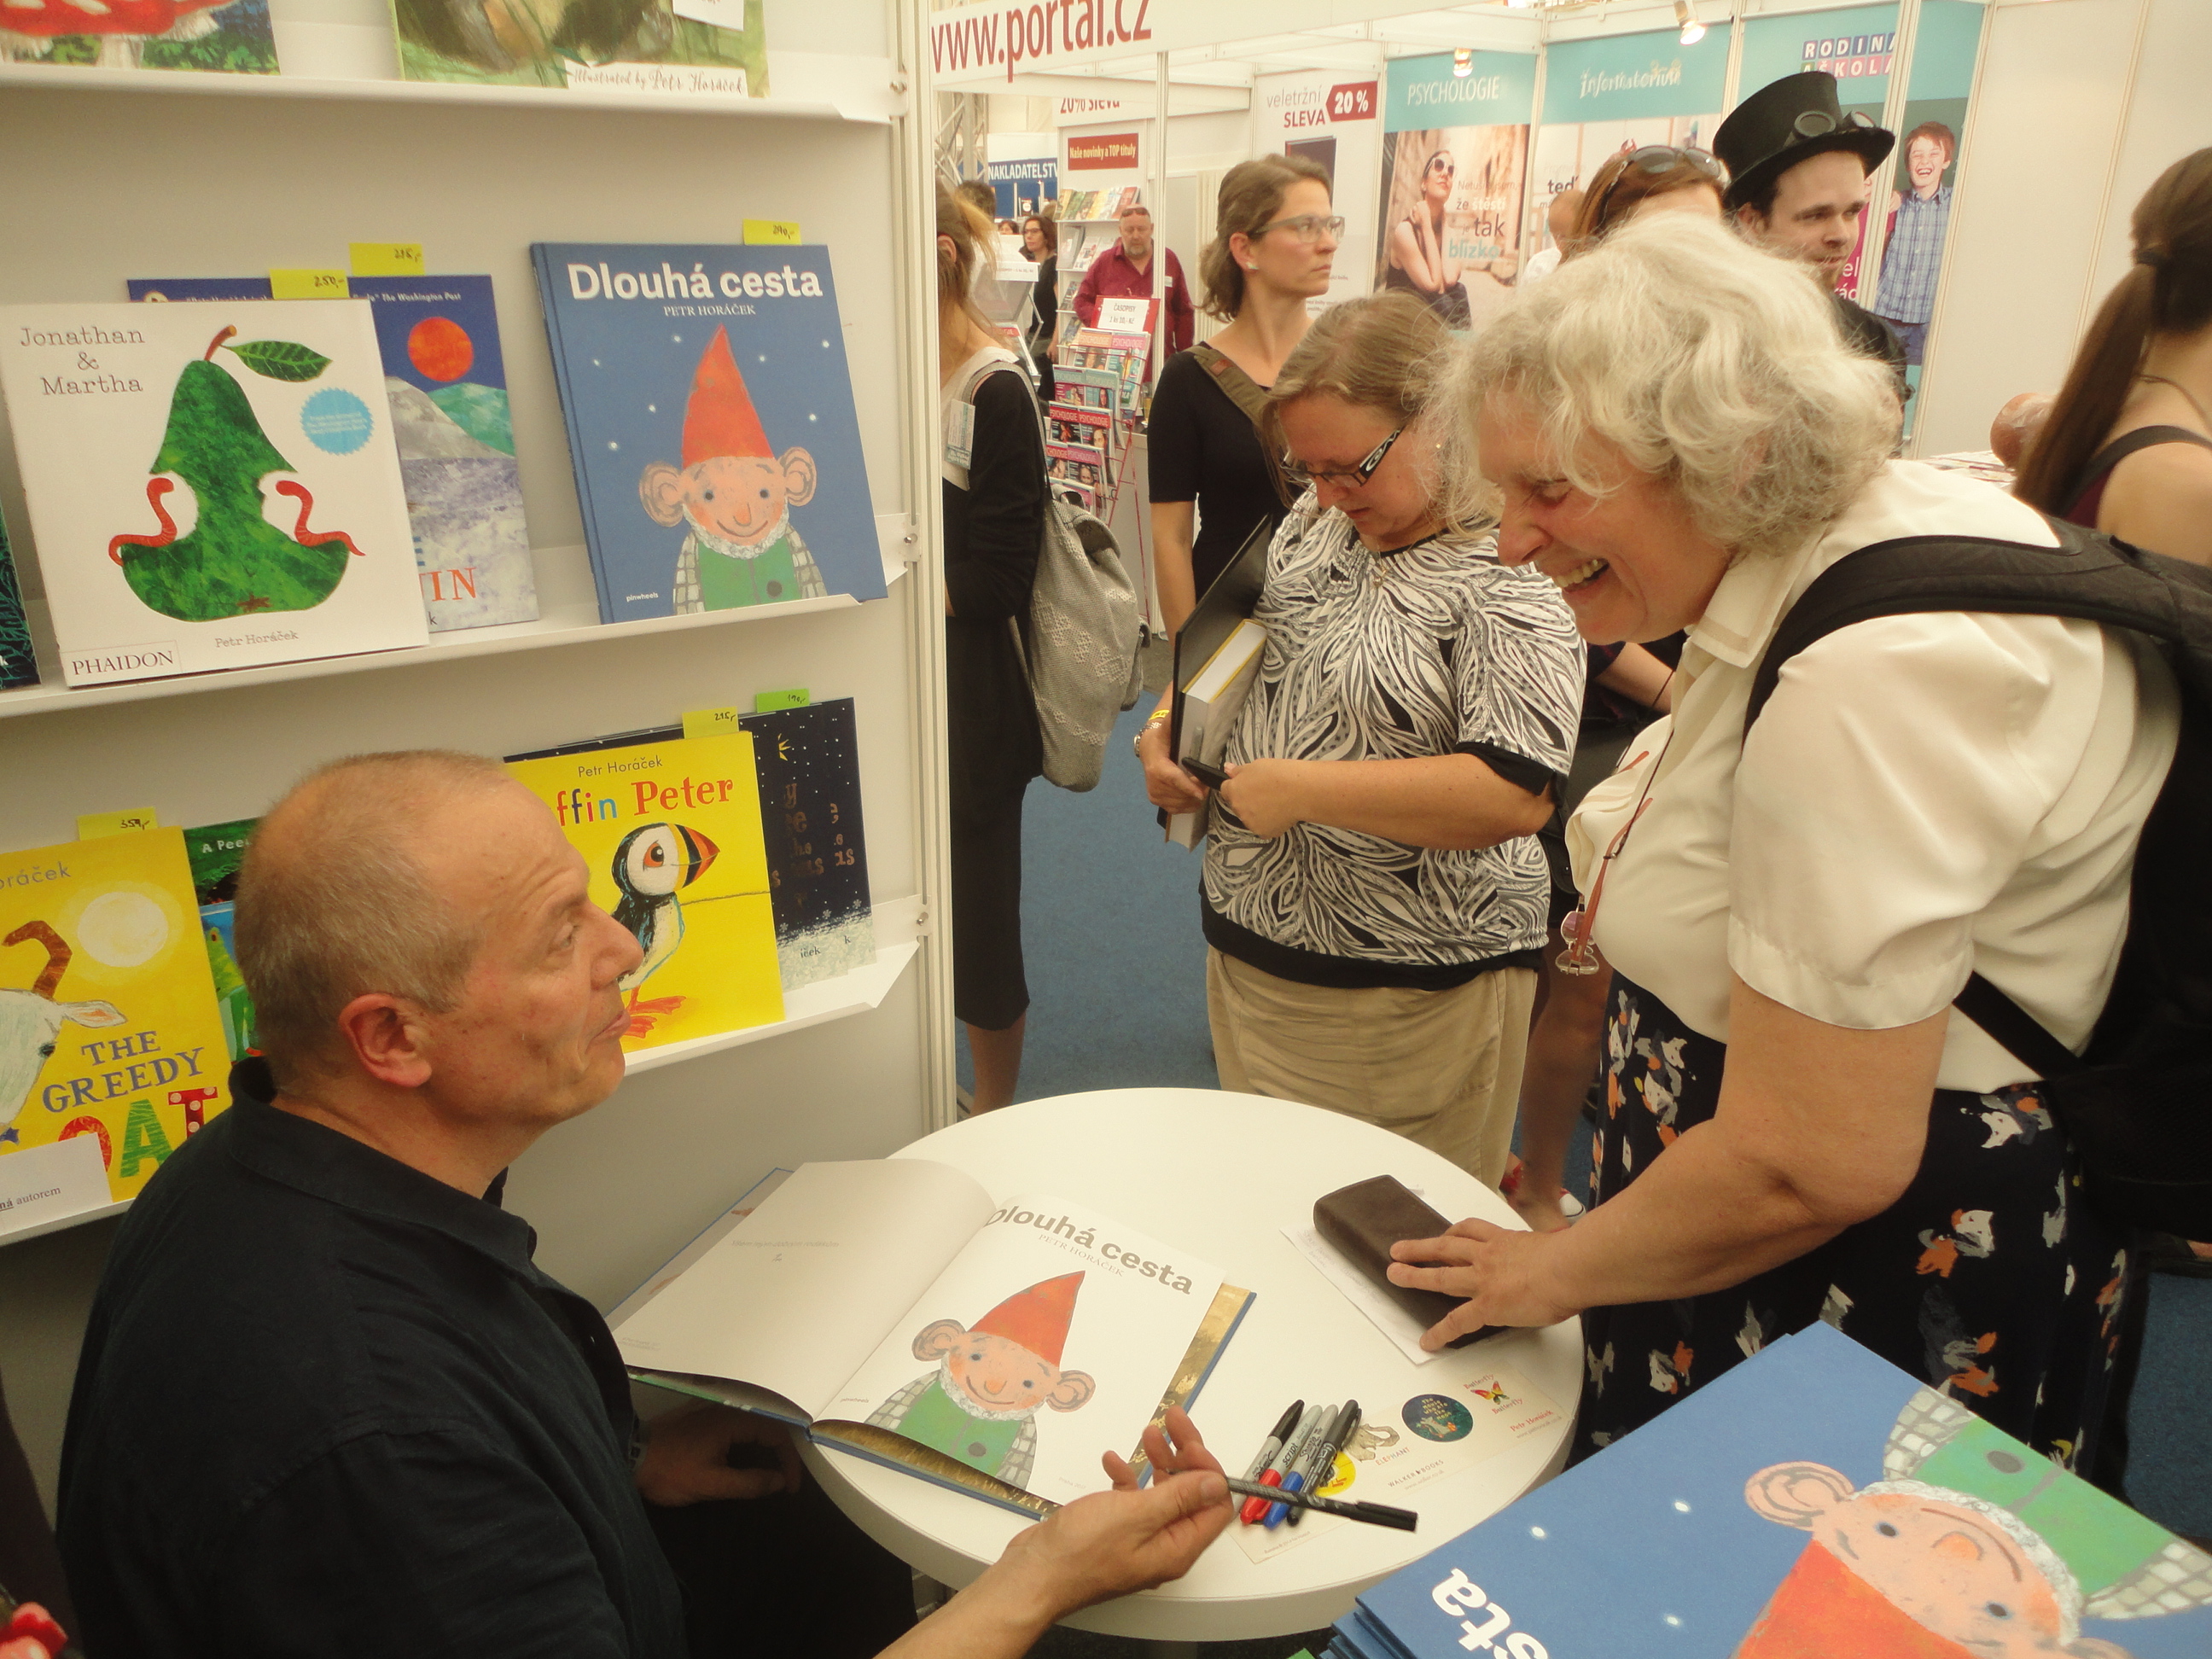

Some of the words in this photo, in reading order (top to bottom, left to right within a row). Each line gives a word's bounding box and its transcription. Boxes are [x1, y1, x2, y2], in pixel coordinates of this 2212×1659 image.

[635, 70, 646, 90] by
[649, 65, 682, 91] Petr
[1266, 84, 1323, 108] veletržní
[1407, 75, 1500, 106] PSYCHOLOGIE
[1284, 108, 1325, 129] SLEVA
[1083, 145, 1104, 160] novinky
[1109, 144, 1121, 156] TOP
[1121, 143, 1137, 159] tituly
[1456, 198, 1469, 211] že
[1474, 213, 1505, 237] tak
[1448, 237, 1500, 259] blízko
[567, 262, 713, 300] Dlouhá
[719, 265, 824, 299] cesta
[382, 294, 395, 302] The
[397, 293, 443, 303] Washington
[444, 292, 462, 301] Post
[663, 306, 696, 317] PETR
[698, 302, 756, 316] HORÁČEK
[20, 326, 145, 347] Jonathan
[77, 351, 100, 370] &
[40, 374, 143, 395] Martha
[626, 591, 659, 602] pinwheels
[214, 635, 243, 649] Petr
[246, 629, 299, 645] Horáček
[72, 649, 174, 676] PHAIDON
[577, 765, 602, 777] Petr
[607, 754, 663, 773] Horáček
[630, 777, 734, 816] Peter
[201, 842, 212, 853] A
[81, 1030, 161, 1067] THE
[43, 1046, 205, 1113] GREEDY
[17, 1187, 61, 1205] autorem
[1038, 1233, 1068, 1250] PETR
[1068, 1245, 1125, 1278] HORÁČEK
[1101, 1242, 1193, 1295] cesta
[1463, 1373, 1494, 1389] Butterfly
[1492, 1398, 1523, 1415] Butterfly
[1510, 1422, 1526, 1432] Petr
[1282, 1441, 1299, 1467] script
[1375, 1447, 1411, 1466] ELEPHANT
[1388, 1471, 1417, 1487] WALKER
[1420, 1458, 1444, 1473] BOOKS
